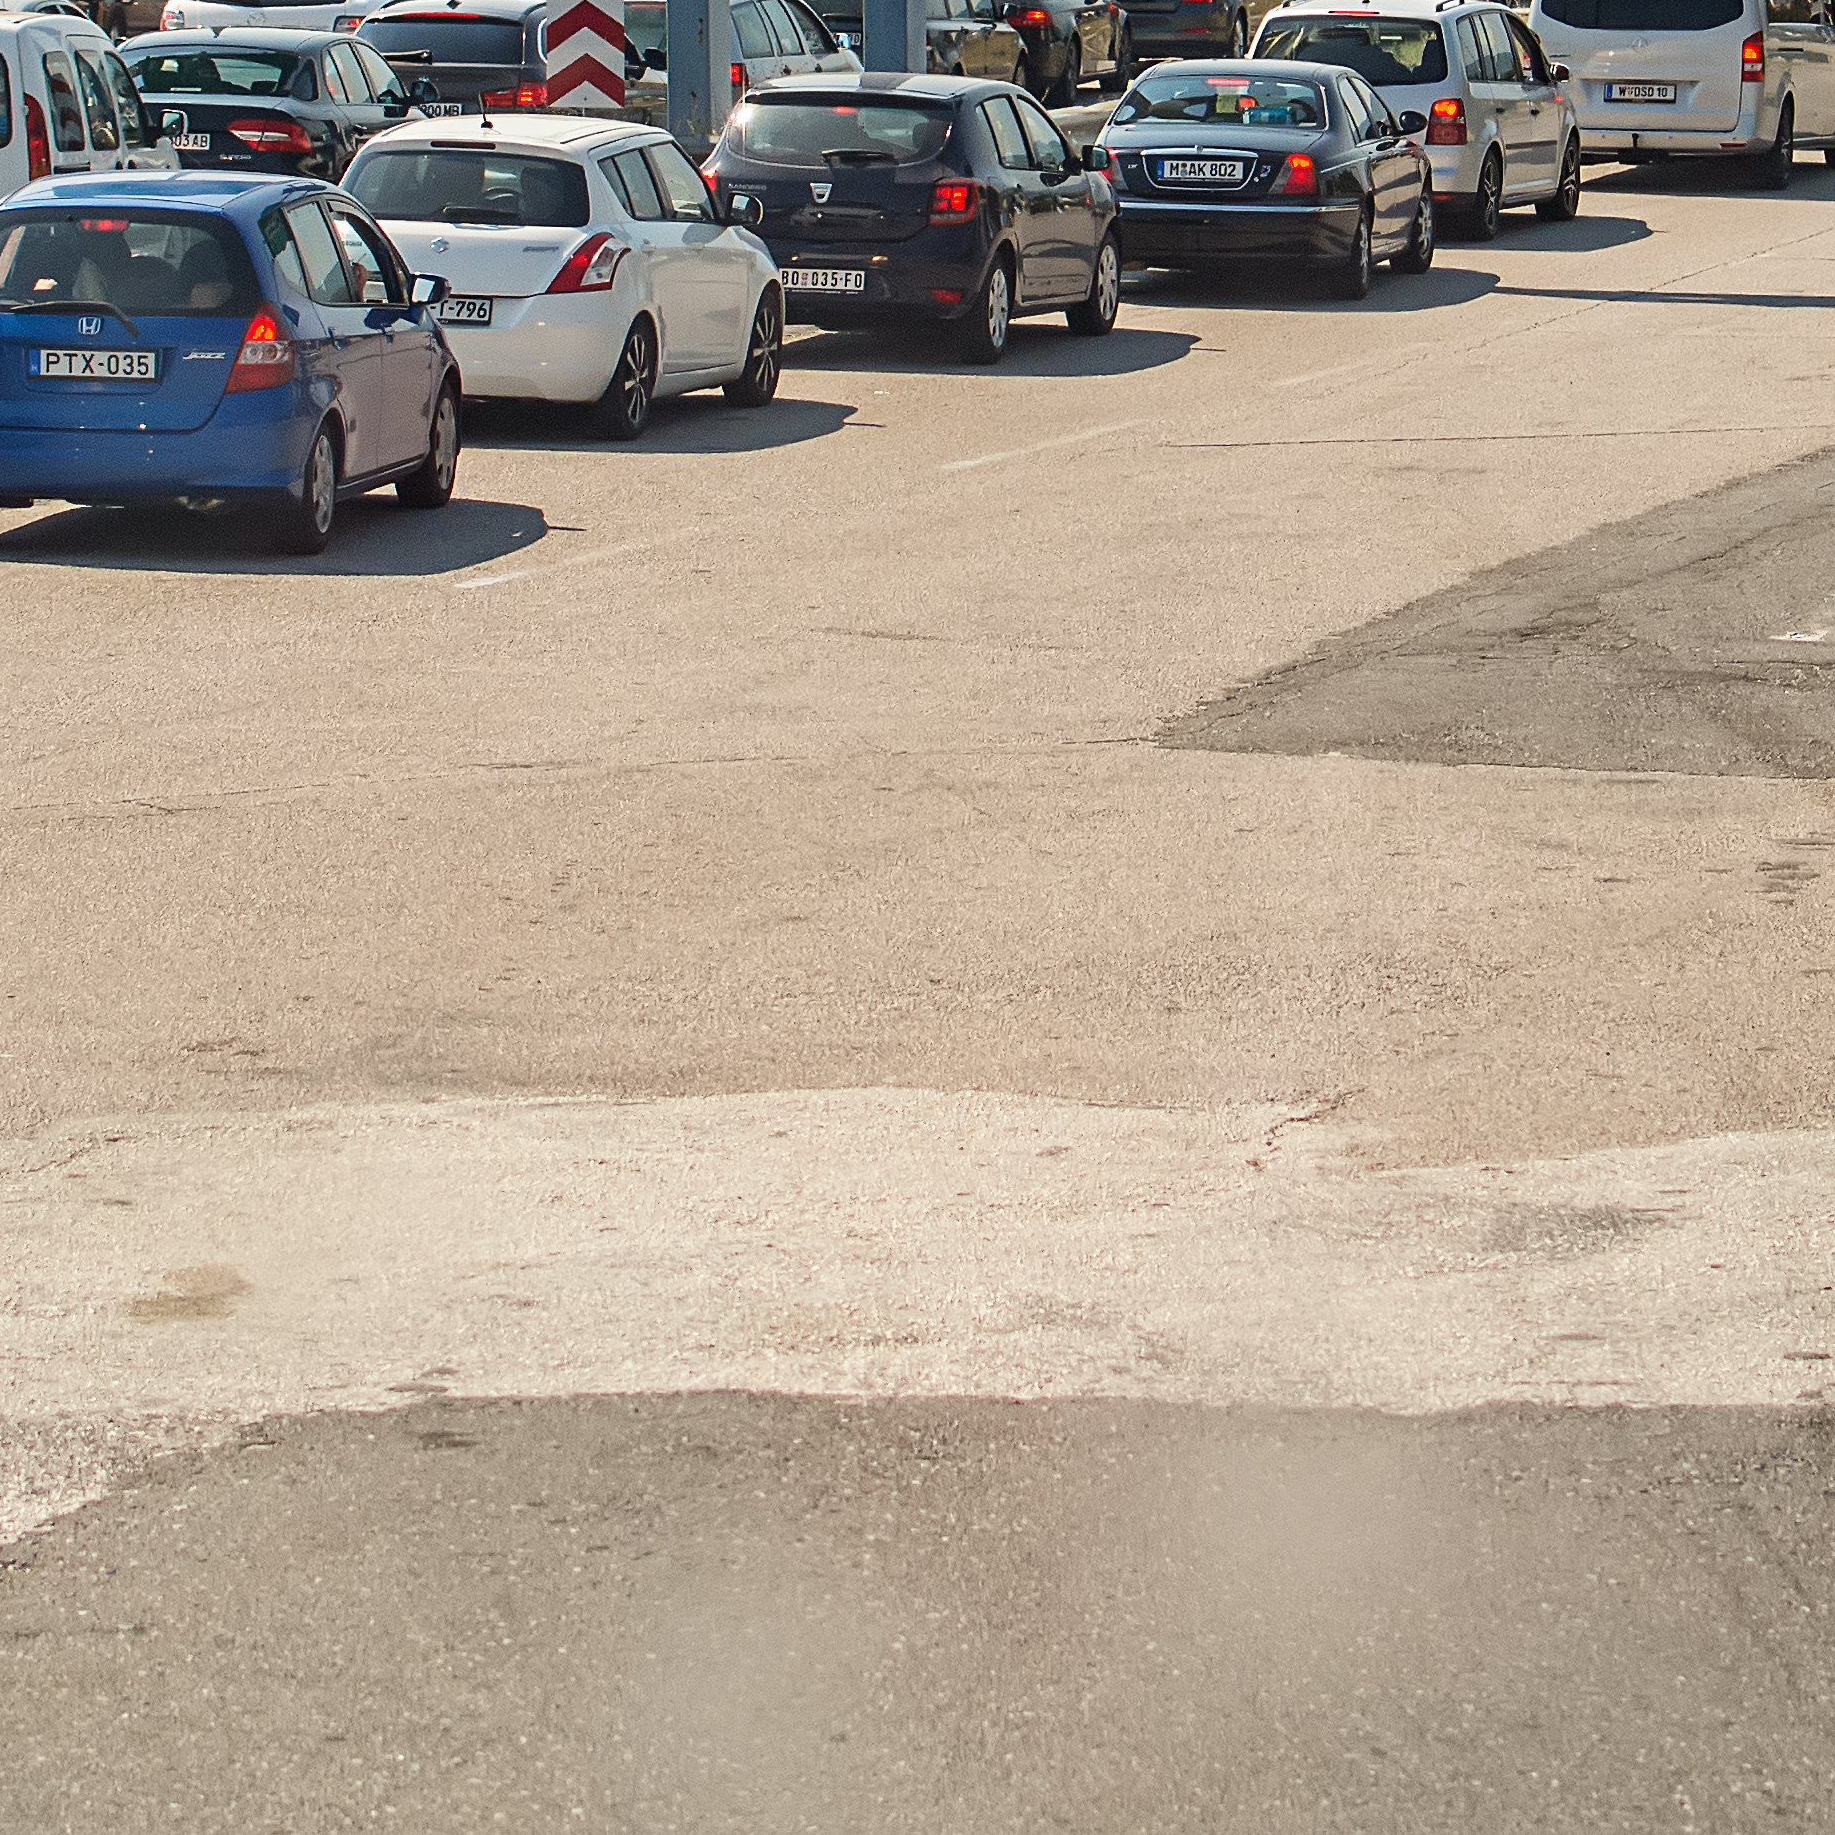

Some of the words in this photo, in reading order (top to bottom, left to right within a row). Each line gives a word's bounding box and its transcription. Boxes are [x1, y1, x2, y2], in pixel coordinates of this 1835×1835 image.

[1618, 87, 1626, 96] W
[1169, 163, 1179, 176] M
[1209, 163, 1236, 177] 802
[46, 352, 149, 376] PTX-035
